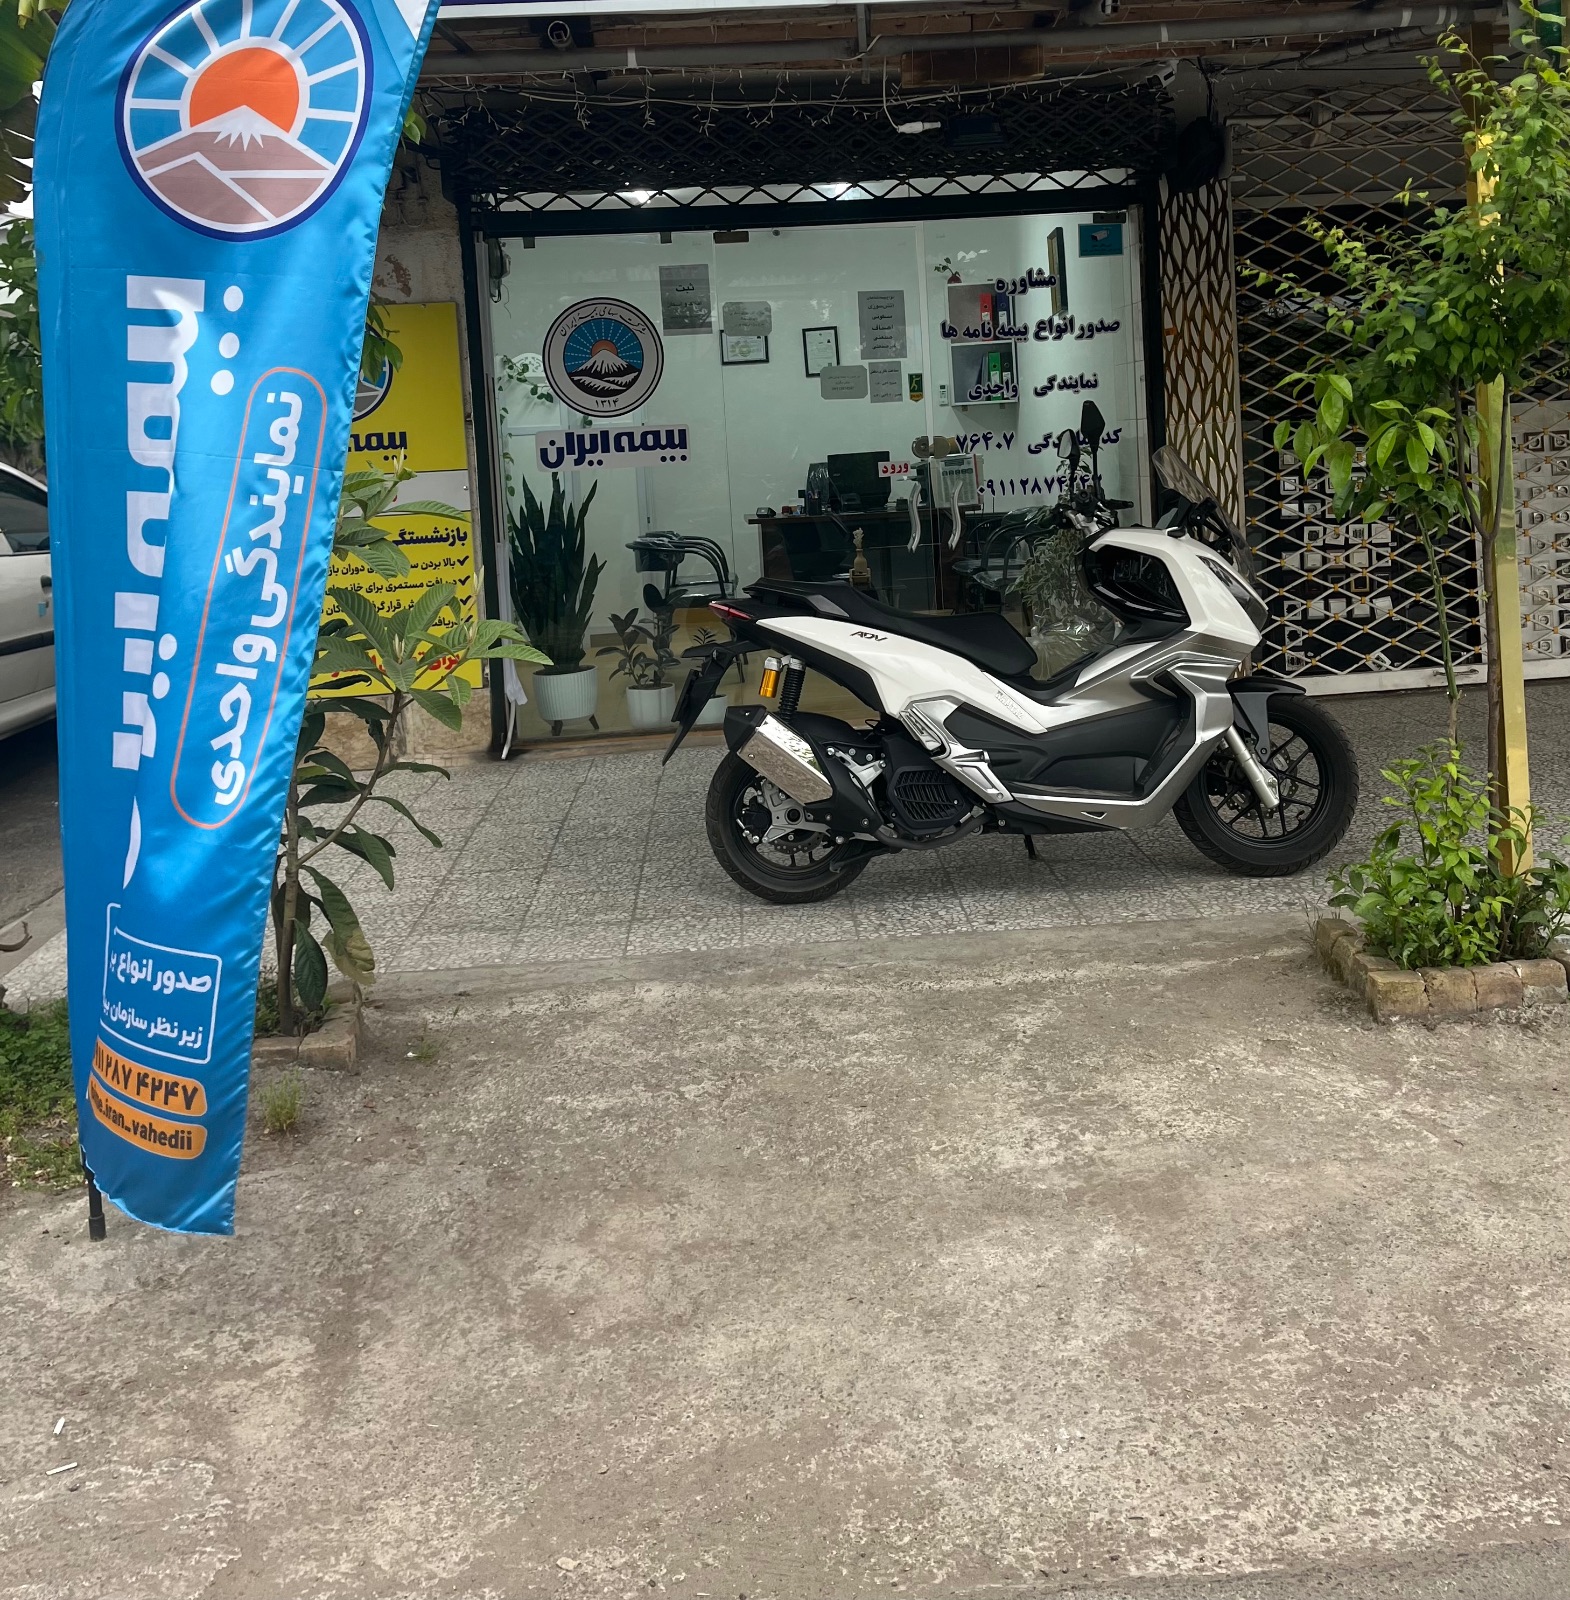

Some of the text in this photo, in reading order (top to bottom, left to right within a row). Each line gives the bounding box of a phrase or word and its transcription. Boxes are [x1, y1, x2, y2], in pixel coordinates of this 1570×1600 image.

[995, 267, 1057, 295] مشاوره
[940, 314, 1121, 342] صدور انواع بیمه نامه ها
[967, 373, 1098, 401] نمایندگی واحدی
[539, 428, 688, 469] بیمه ایران
[955, 430, 1015, 453] ۷۶۴۰۷
[881, 462, 909, 475] ورود
[421, 561, 441, 571] بردن
[443, 557, 456, 570] بالا
[366, 582, 383, 594] برای
[385, 580, 424, 593] مستمری
[210, 391, 303, 807] نمایندگی واحدی
[386, 599, 401, 612] قرار
[850, 631, 888, 642] ADV
[117, 951, 153, 984] انواع
[152, 971, 212, 995] صدور
[110, 1001, 147, 1029] سازمان
[148, 1017, 178, 1038] نظر
[178, 1026, 203, 1048] زیر
